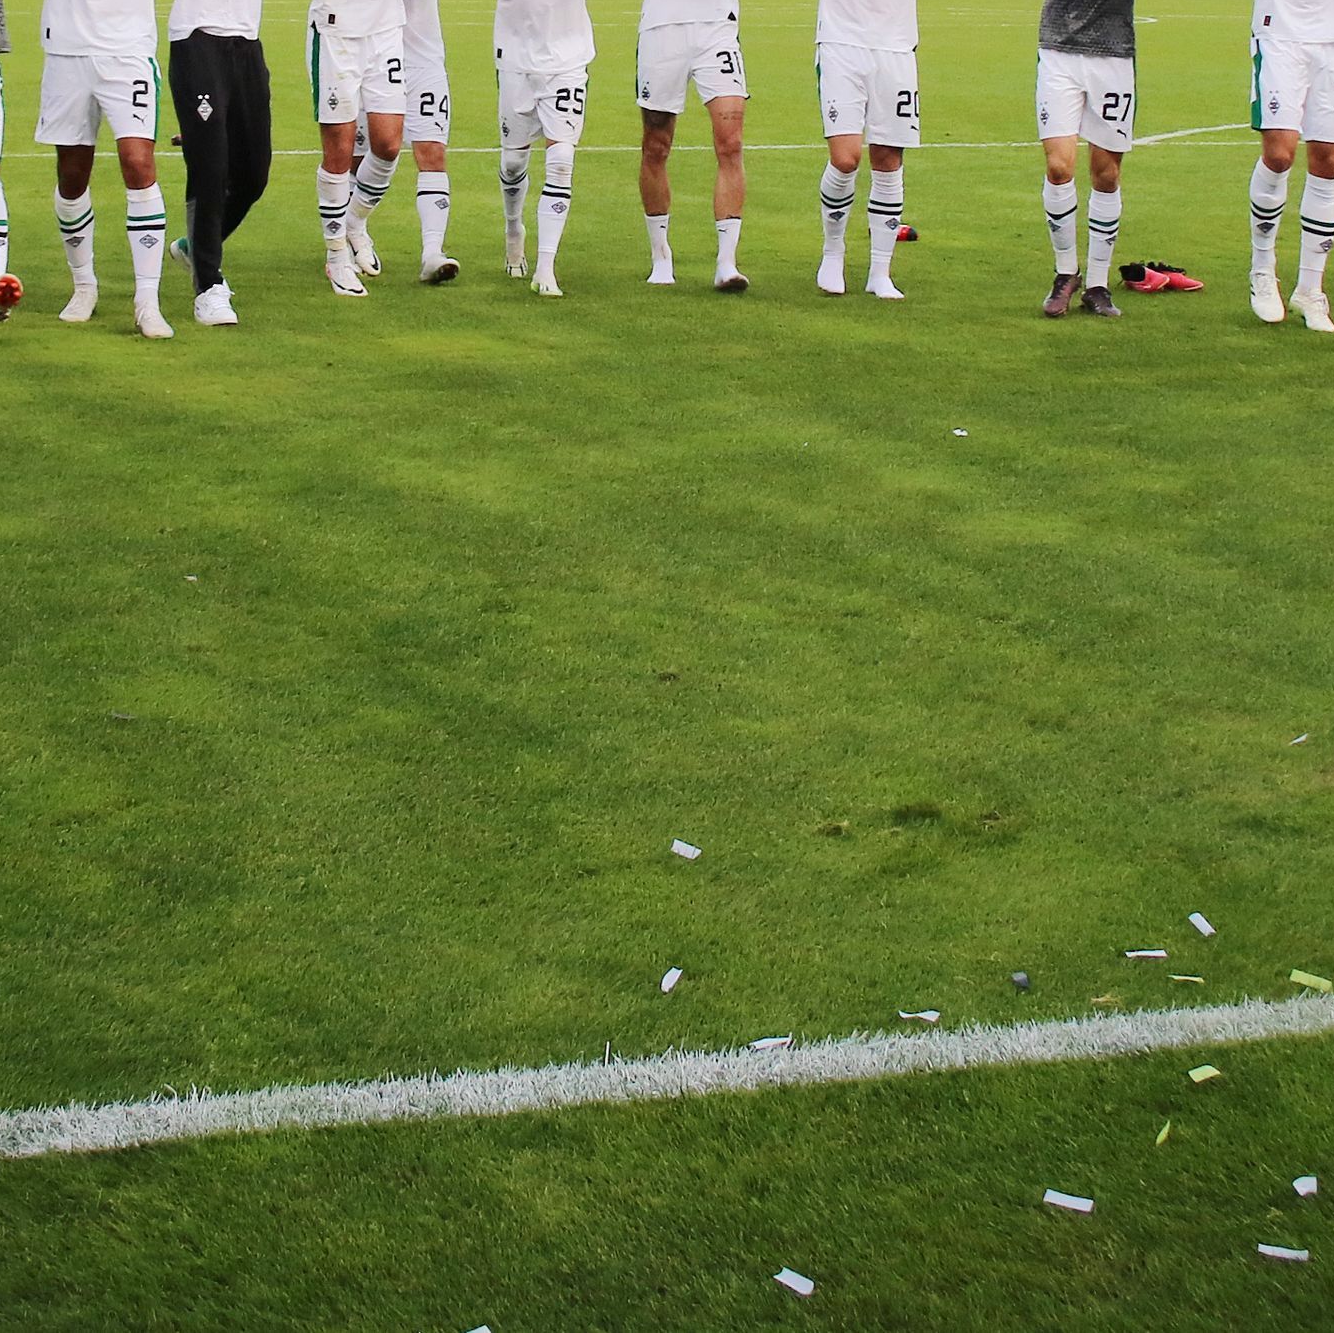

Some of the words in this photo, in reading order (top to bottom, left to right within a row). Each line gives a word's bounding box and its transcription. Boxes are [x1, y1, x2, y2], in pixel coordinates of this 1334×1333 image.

[132, 79, 149, 107] 2
[420, 91, 450, 120] 24
[555, 87, 584, 115] 25
[1102, 92, 1131, 122] 27
